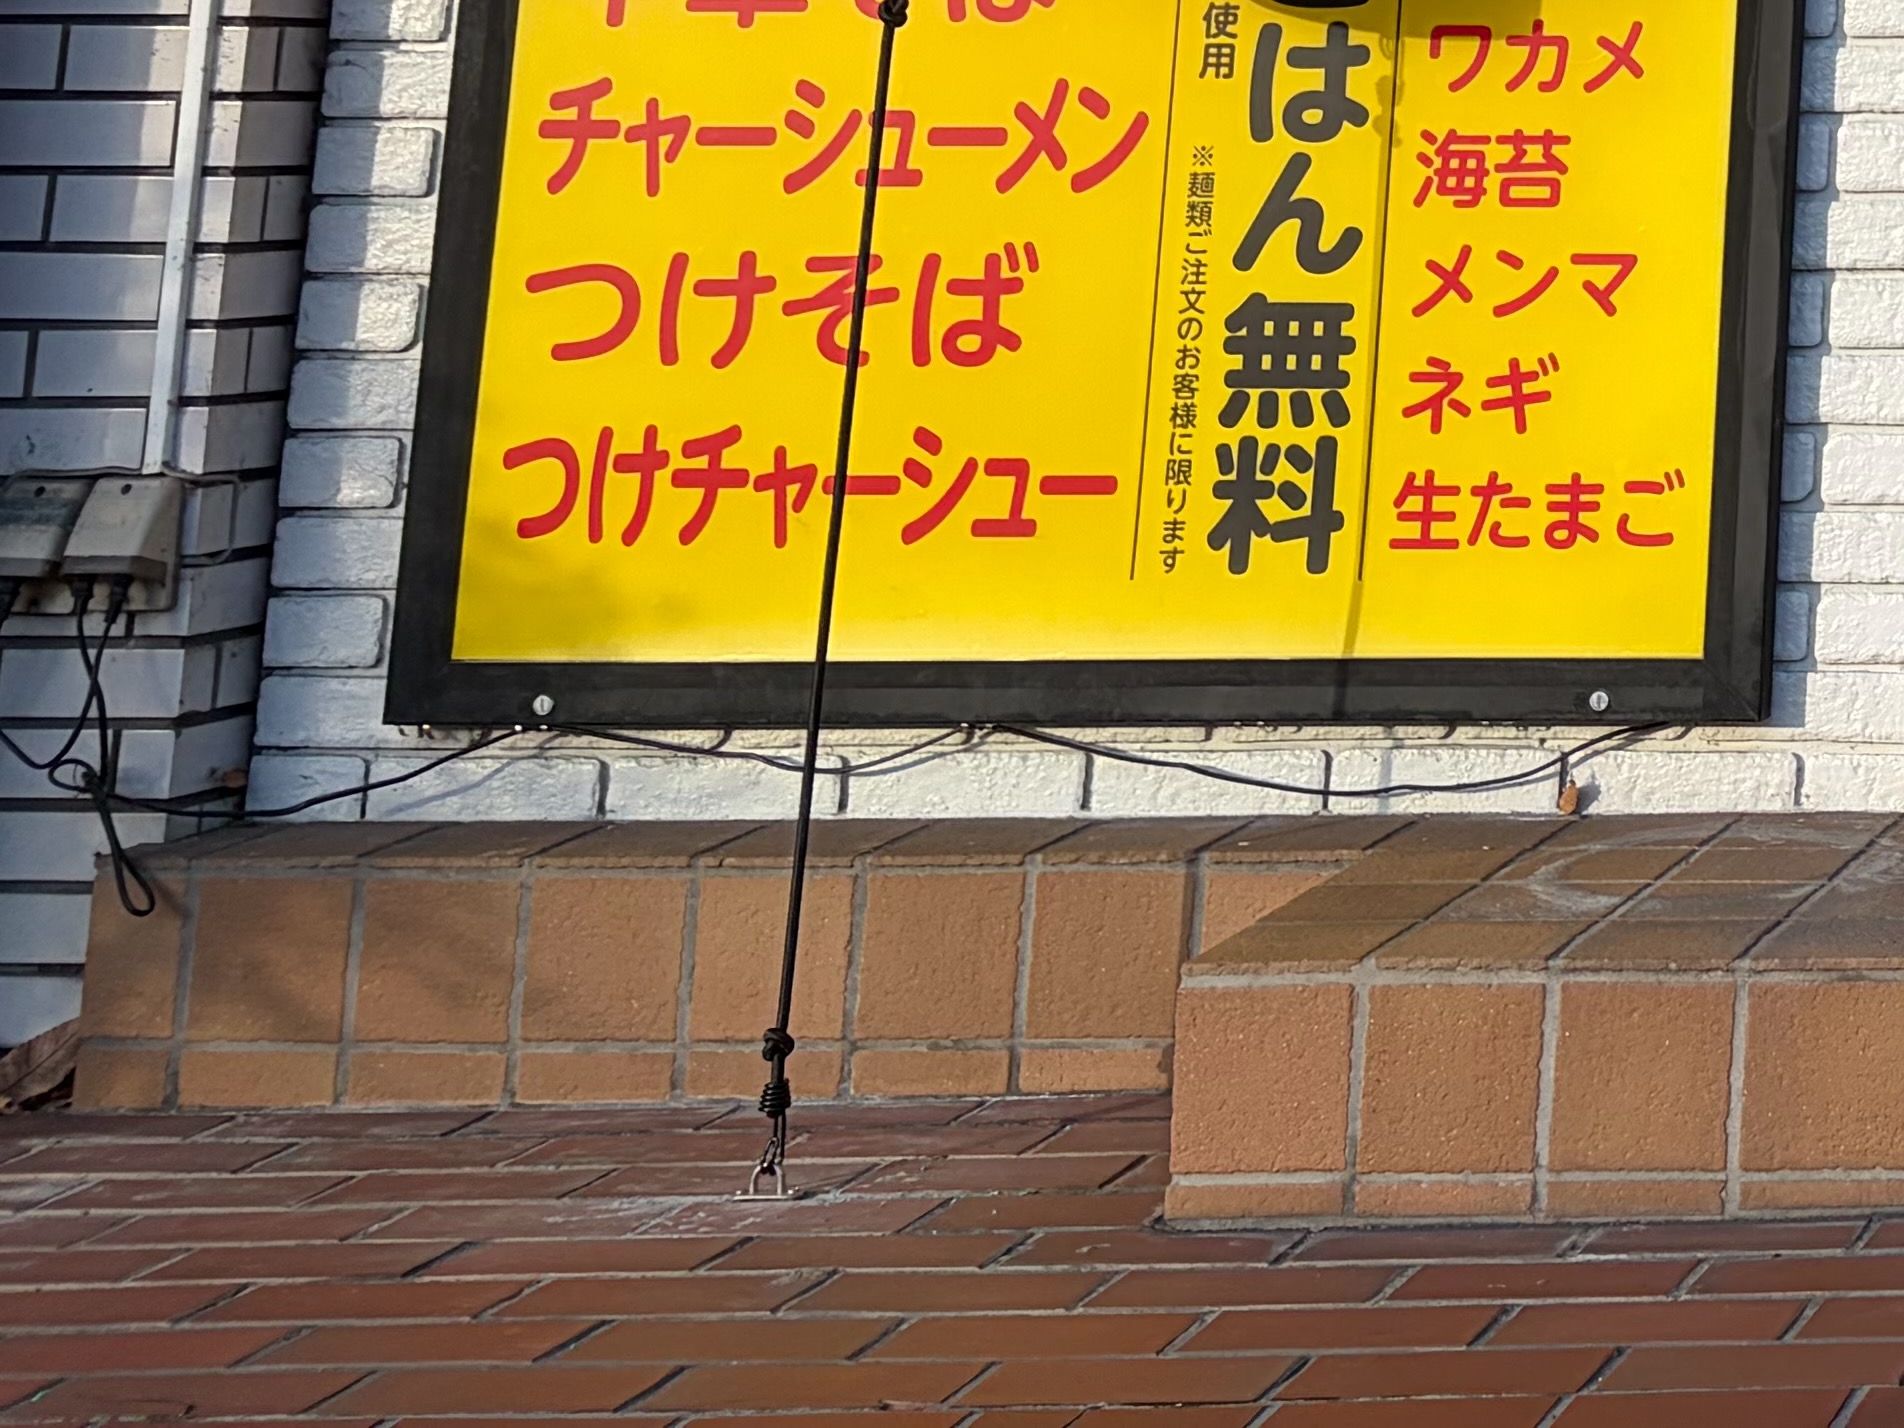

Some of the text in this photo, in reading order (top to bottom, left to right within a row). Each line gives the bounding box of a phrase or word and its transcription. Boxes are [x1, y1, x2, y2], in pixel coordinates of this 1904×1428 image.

[1428, 19, 1648, 93] ワカメ
[538, 78, 1149, 196] チャーシューメン
[1414, 128, 1571, 208] 海苔
[526, 243, 1039, 369] つけそば
[1412, 245, 1638, 318] メンマ
[1402, 352, 1560, 435] ネギ
[503, 425, 1118, 547] つけチャーシュー
[1390, 468, 1686, 552] 生たまご
